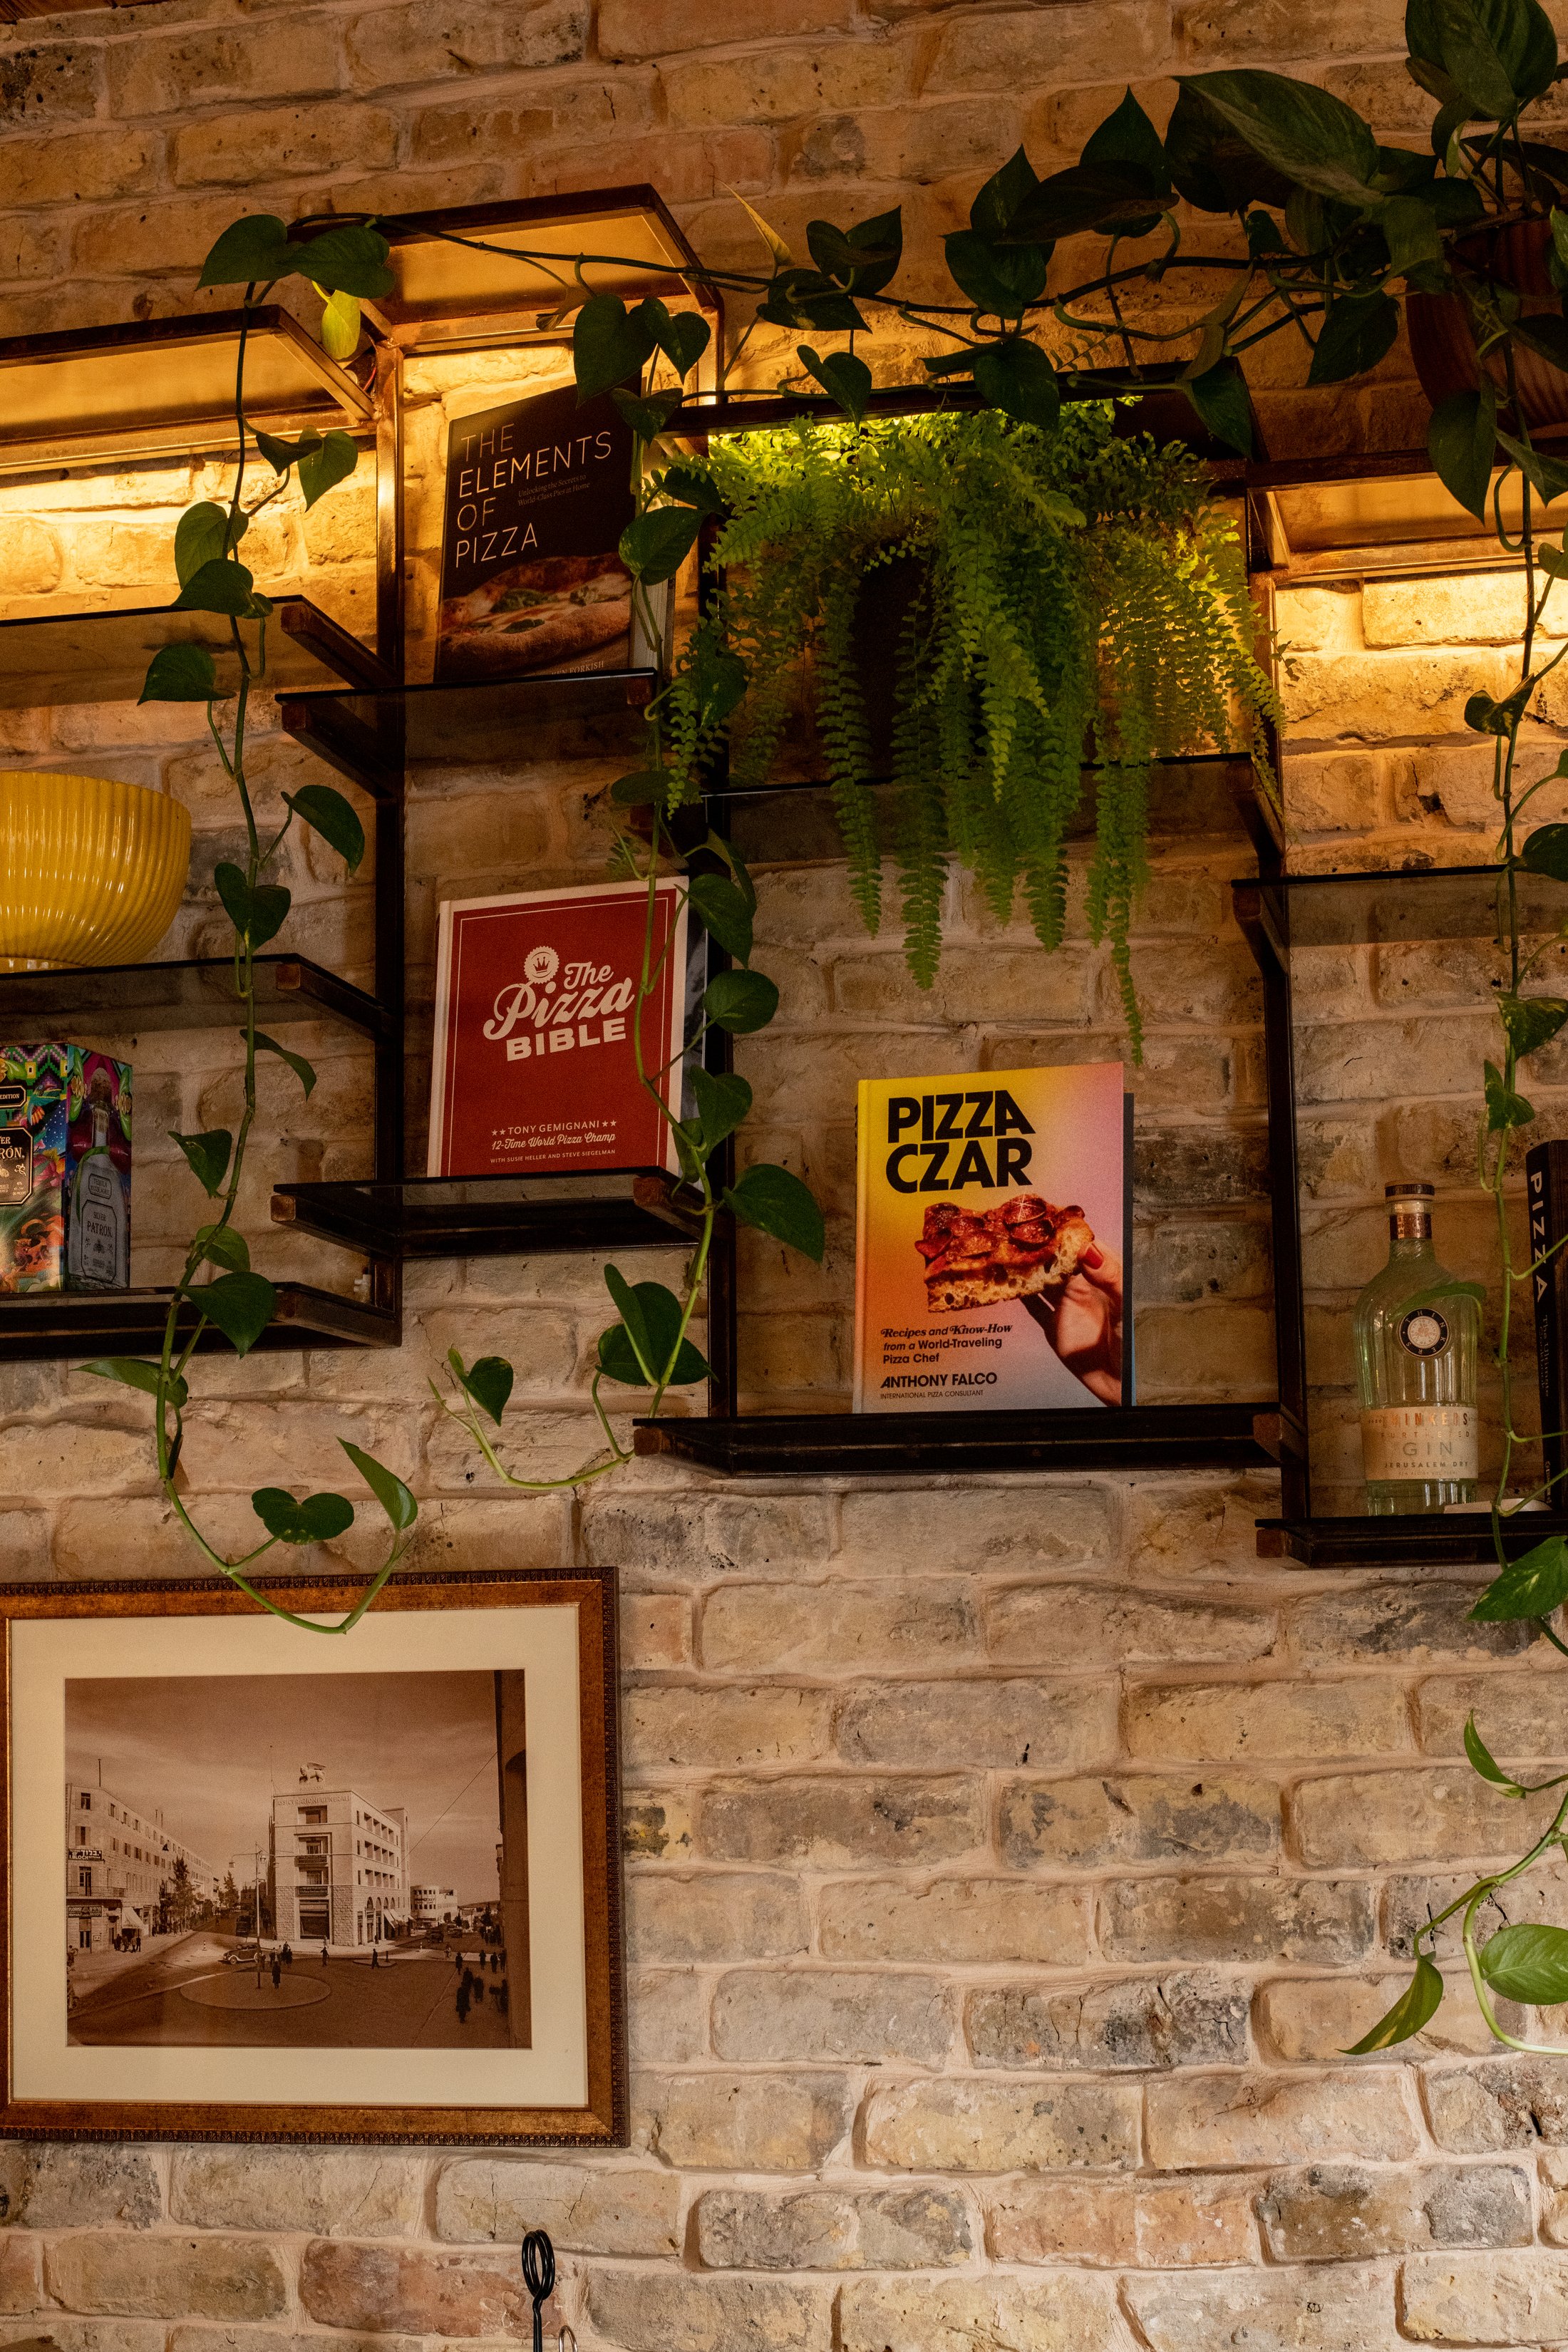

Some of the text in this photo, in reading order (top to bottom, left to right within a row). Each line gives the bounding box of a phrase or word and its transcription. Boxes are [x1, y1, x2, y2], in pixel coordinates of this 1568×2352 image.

[460, 423, 515, 462] THE
[459, 431, 612, 498] ELEMENTS
[517, 492, 552, 506] World-Class
[572, 483, 590, 492] Home
[518, 485, 547, 497] Unlocking
[548, 481, 557, 490] the
[558, 477, 579, 487] Secrets
[457, 497, 497, 531] OF
[456, 522, 537, 568] PIZZA
[569, 661, 604, 674] FORKISH
[564, 961, 614, 990] The
[483, 977, 635, 1041] Pizza
[506, 1017, 626, 1062] BIBLE
[507, 1120, 600, 1135] TONY GEMIGNANI
[888, 1090, 1036, 1144] PIZZA
[492, 1132, 616, 1150] 12-Time World Pizza Champ
[886, 1138, 1032, 1194] CZAR
[1530, 1171, 1547, 1303] PIZZA
[881, 1324, 1013, 1339] Recipes and Know-How
[883, 1343, 906, 1351] from
[918, 1338, 1002, 1349] World-Traveling
[1405, 1310, 1447, 1355] THINKERS
[883, 1353, 940, 1364] Pizza Chef
[880, 1372, 998, 1389] ANTHONY FALCO
[1403, 1441, 1453, 1456] GIN
